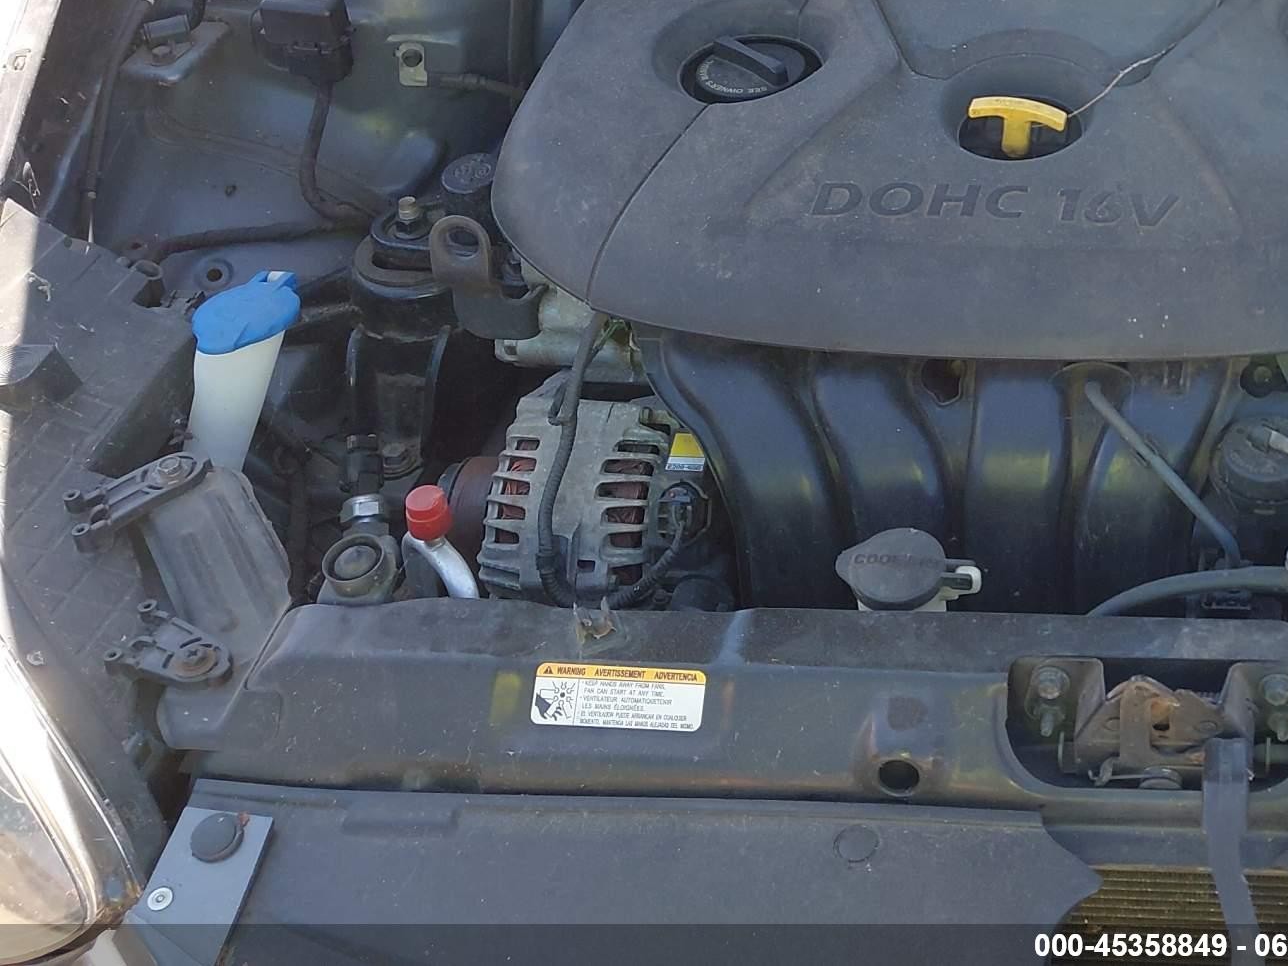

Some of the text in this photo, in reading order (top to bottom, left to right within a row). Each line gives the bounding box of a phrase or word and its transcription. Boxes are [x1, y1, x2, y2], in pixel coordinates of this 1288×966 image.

[809, 181, 1180, 227] DOHC 16V
[557, 666, 697, 682] WARNING AVERTISSEMENT ADVERTENCIA
